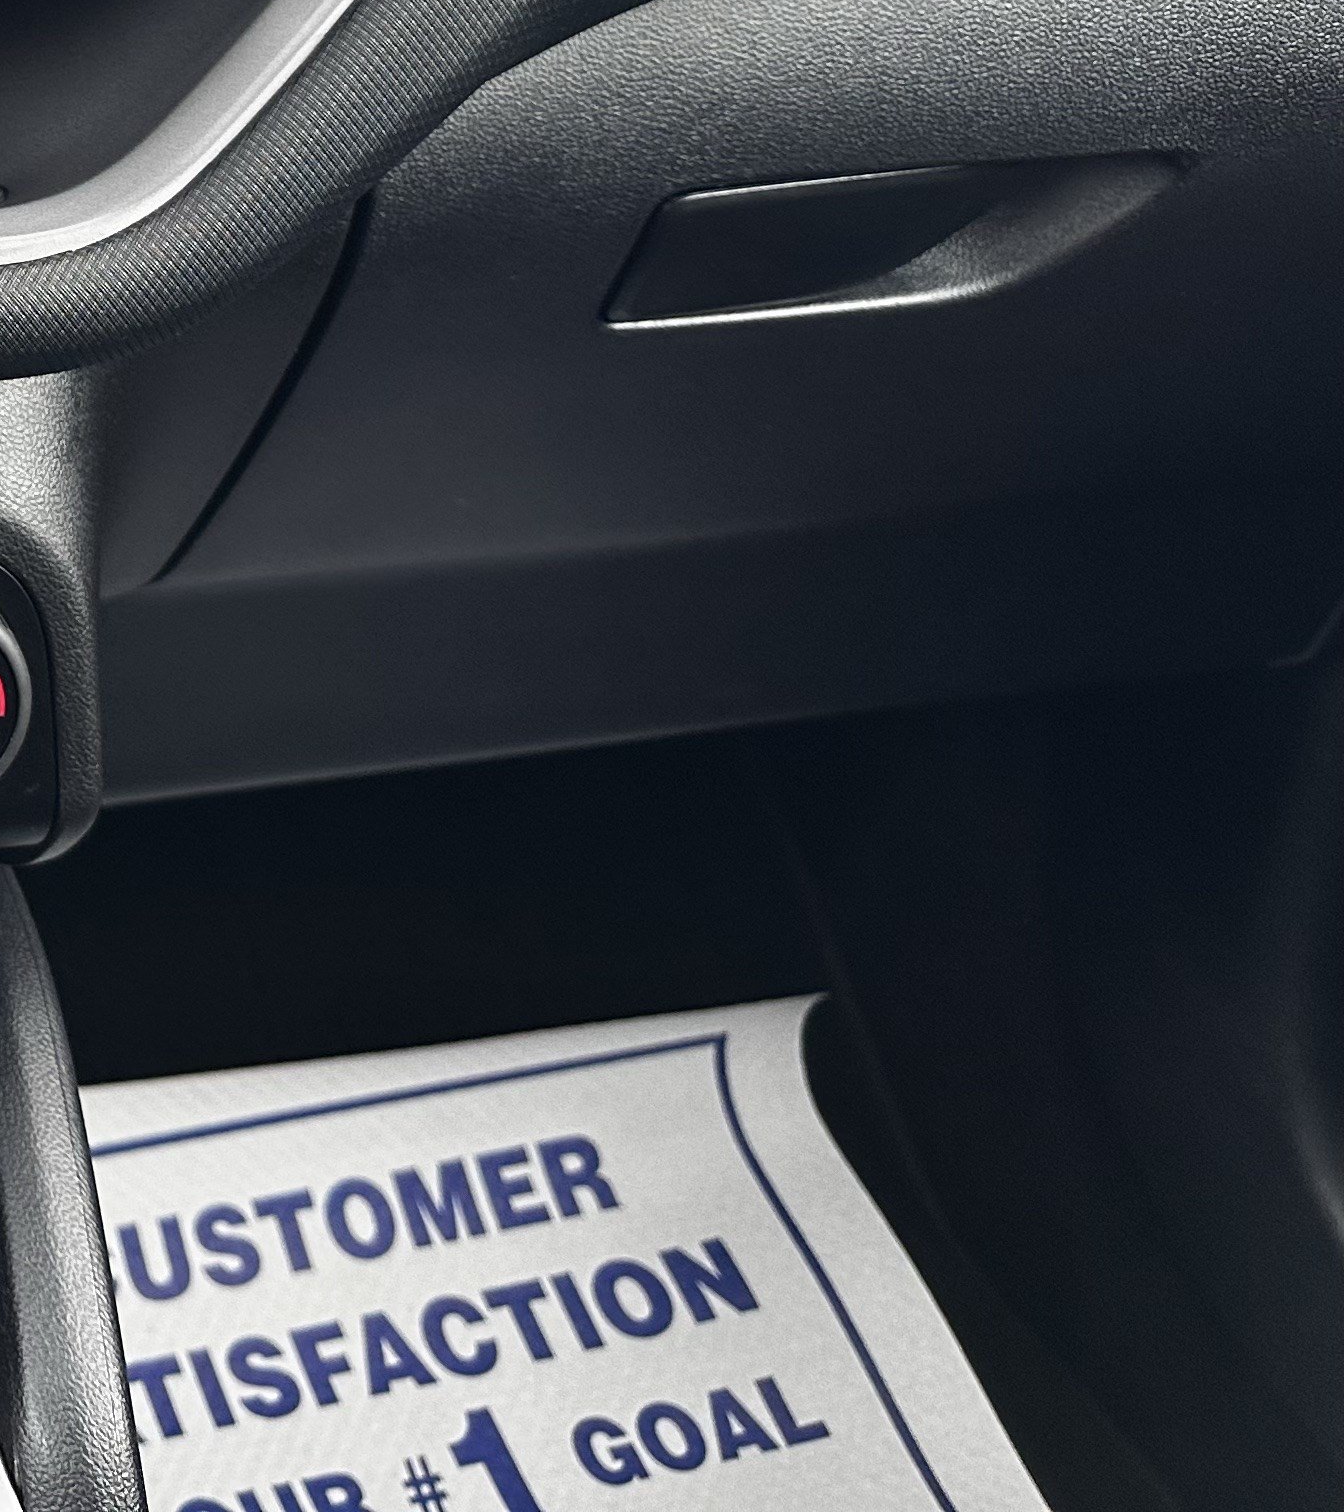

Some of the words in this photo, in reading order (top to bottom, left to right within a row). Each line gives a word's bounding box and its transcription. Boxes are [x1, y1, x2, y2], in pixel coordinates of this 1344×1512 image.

[113, 1133, 620, 1301] USTOMER
[127, 1237, 760, 1444] TISFACTION
[571, 1376, 831, 1487] GOAL
